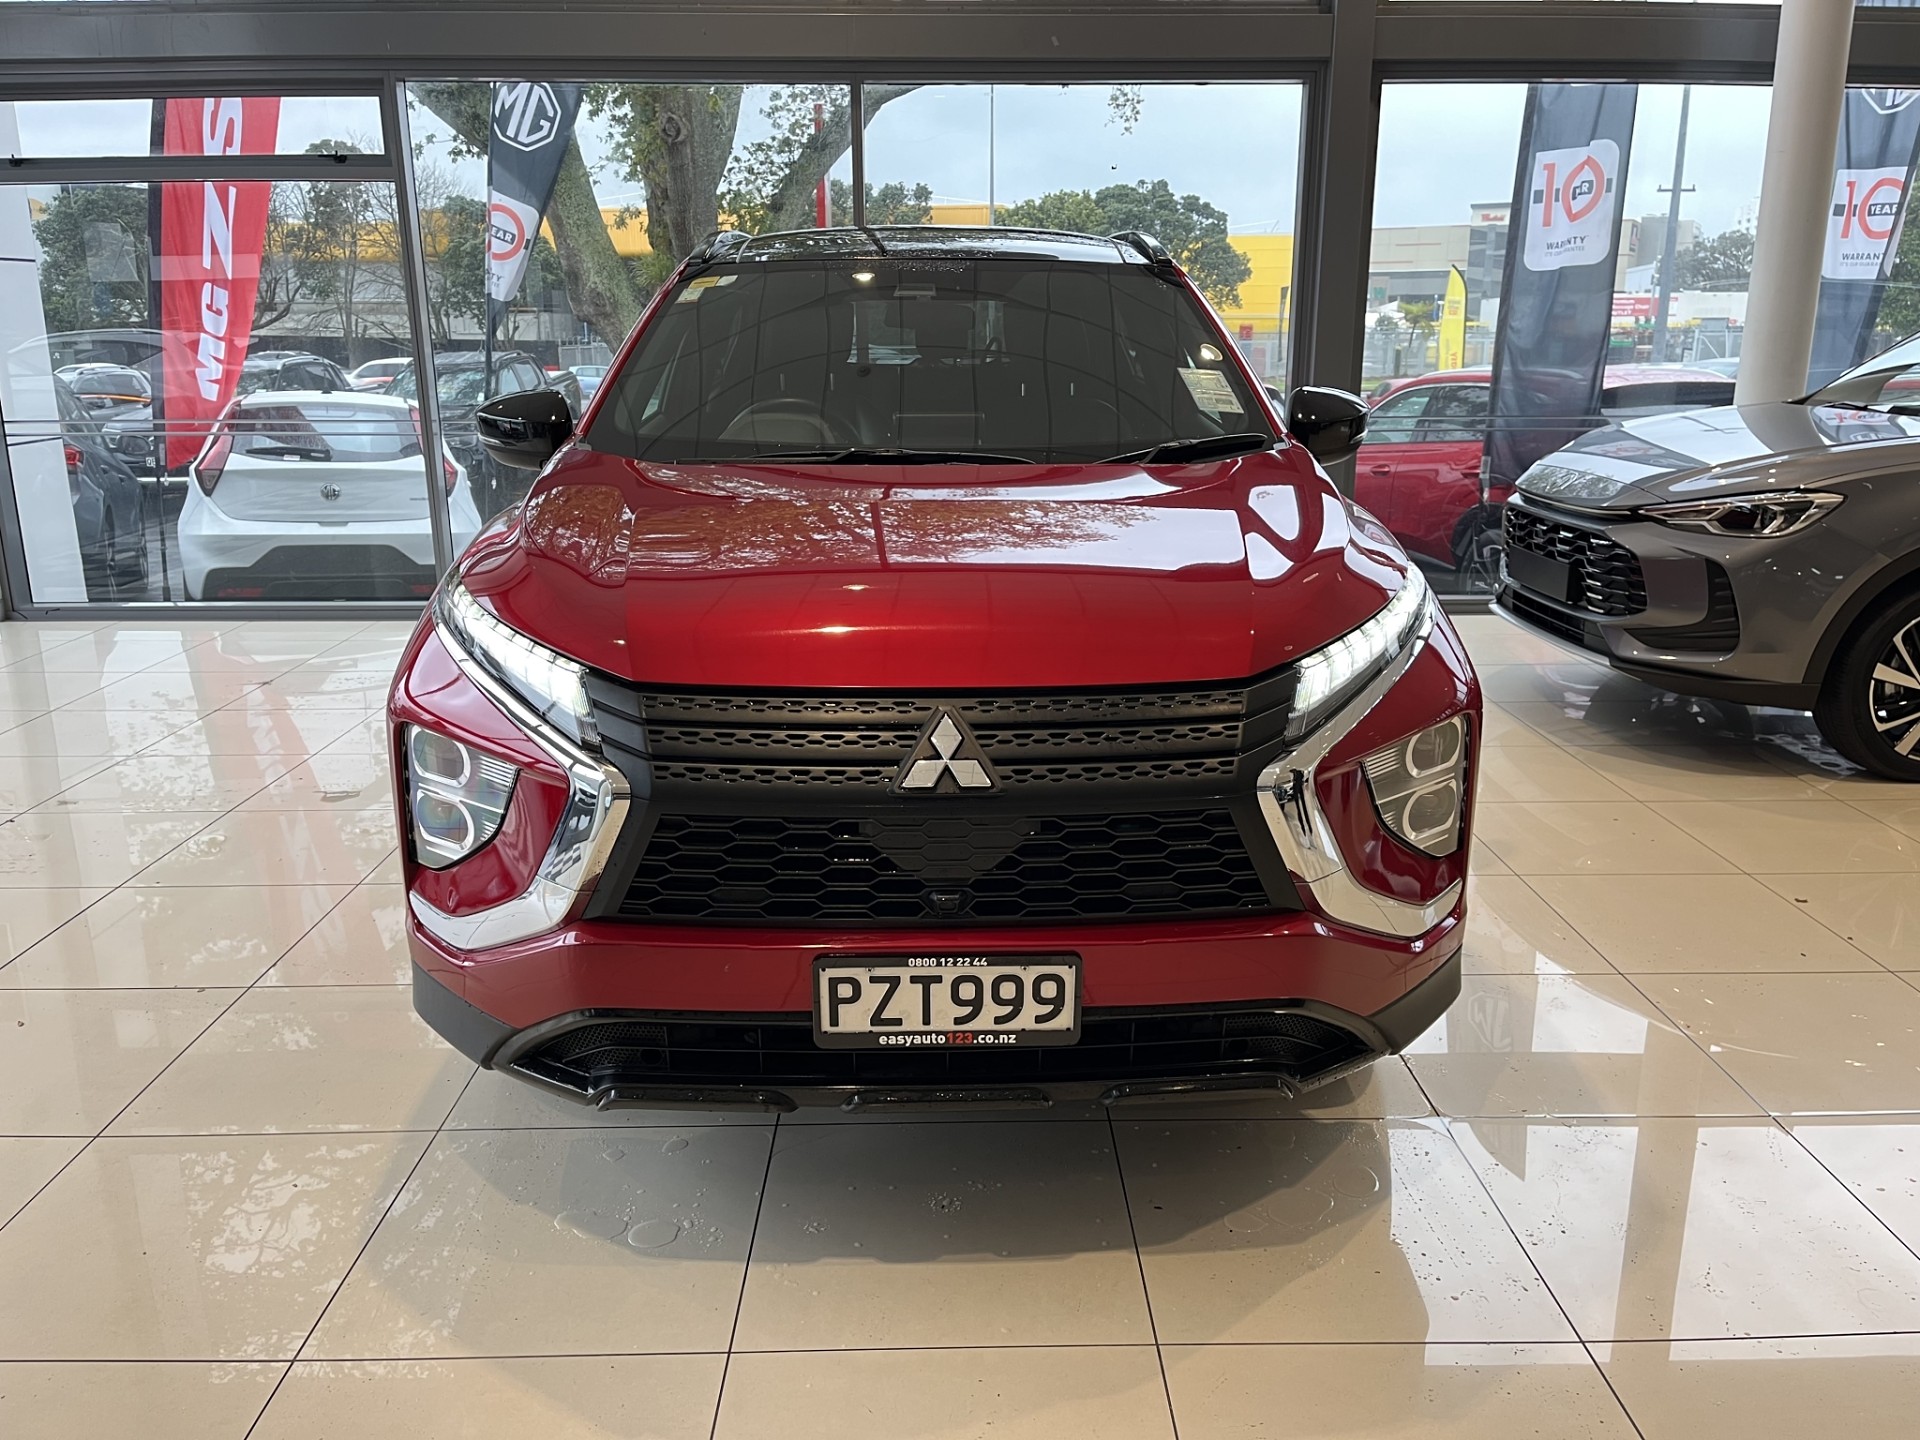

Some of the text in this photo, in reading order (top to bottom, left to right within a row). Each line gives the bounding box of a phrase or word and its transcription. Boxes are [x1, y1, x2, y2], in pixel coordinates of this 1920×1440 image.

[494, 82, 554, 144] MG
[490, 225, 514, 244] EAR
[1841, 252, 1884, 261] WARRAN
[194, 281, 229, 401] MG
[908, 957, 988, 967] 0800 12 22 44
[828, 973, 1066, 1027] PZT999
[878, 1032, 1017, 1046] easyauto123.co.nz
